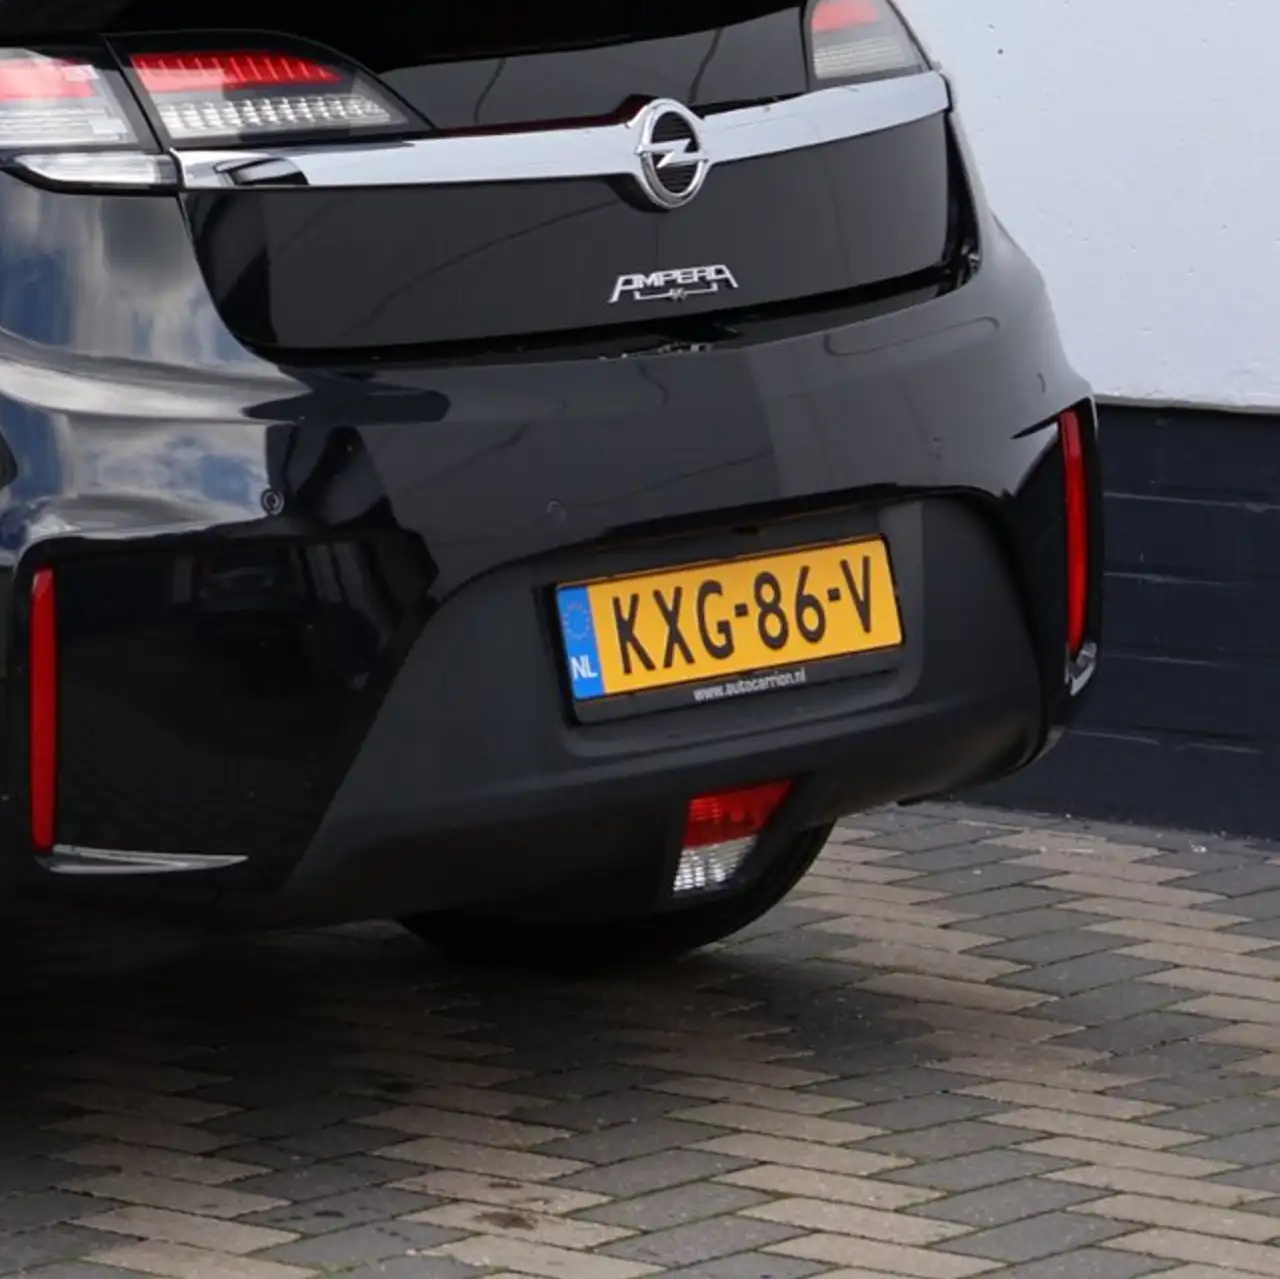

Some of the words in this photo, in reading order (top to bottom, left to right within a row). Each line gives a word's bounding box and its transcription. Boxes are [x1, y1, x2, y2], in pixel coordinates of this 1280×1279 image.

[606, 264, 739, 304] AMPERA
[611, 554, 873, 675] KXG-86-V
[570, 654, 598, 680] NL
[692, 667, 807, 702] www.autocarrion.nl
